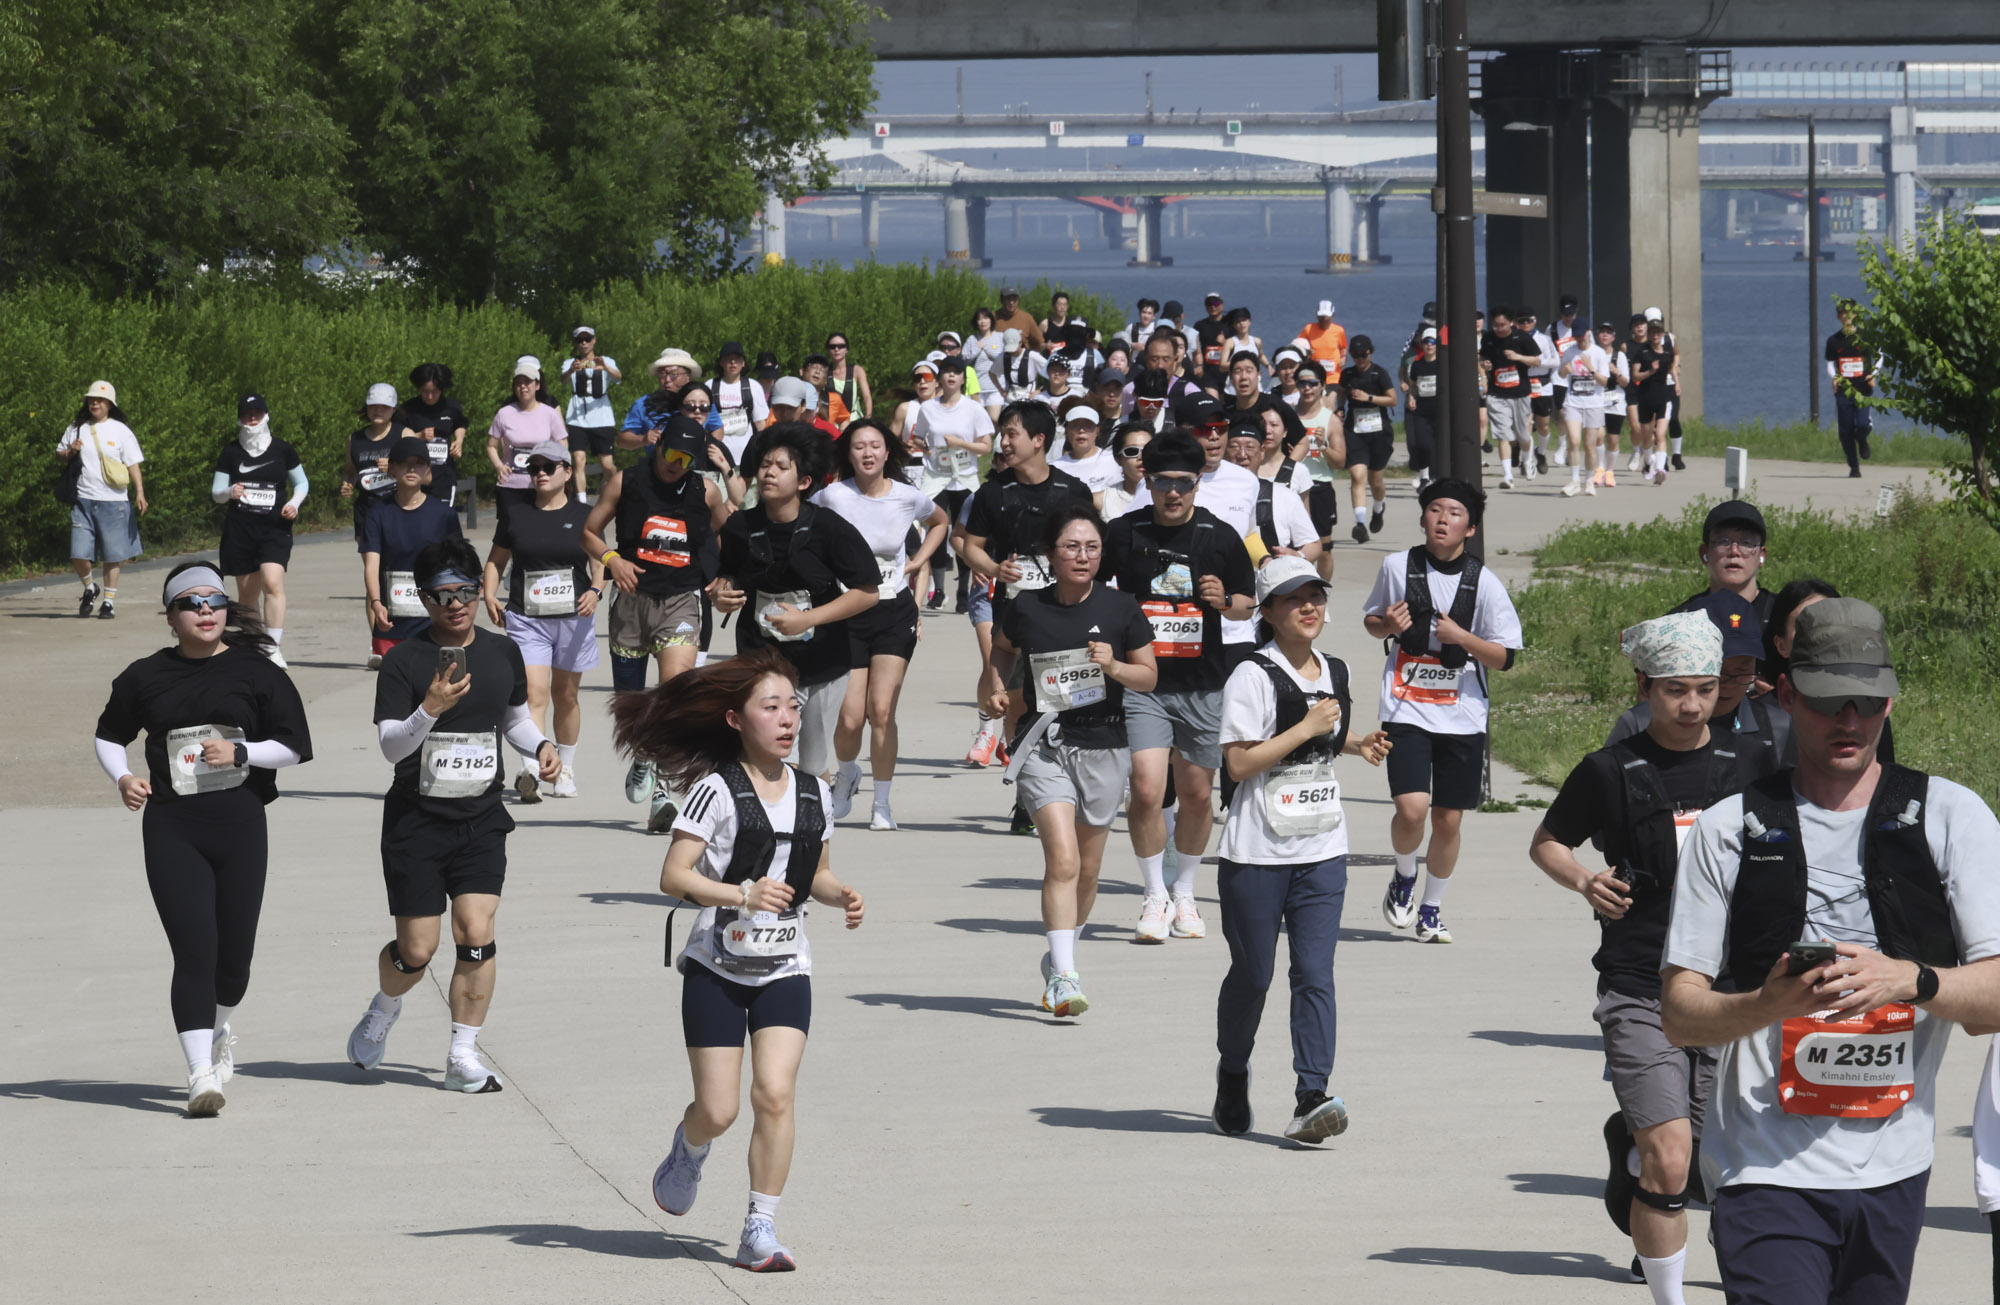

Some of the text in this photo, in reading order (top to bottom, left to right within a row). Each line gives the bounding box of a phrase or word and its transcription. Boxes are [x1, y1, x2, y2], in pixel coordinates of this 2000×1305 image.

[533, 584, 573, 596] W 5827
[1161, 621, 1200, 634] 2063
[1046, 667, 1102, 685] W 5962
[1418, 668, 1457, 681] 2095
[1077, 690, 1097, 702] A-42
[169, 728, 213, 741] BURNING RUN
[426, 735, 456, 744] BURNING
[184, 753, 196, 764] W
[435, 754, 495, 770] M 5182
[1268, 769, 1299, 778] BURNING
[1298, 768, 1314, 776] RUN
[1281, 785, 1336, 805] W 5621
[1749, 854, 1784, 862] SALOMON
[731, 925, 797, 944] W 7720
[1886, 1011, 1909, 1021] 10km
[1807, 1041, 1907, 1068] M 2351
[1820, 1071, 1897, 1083] Kimahni Emsley
